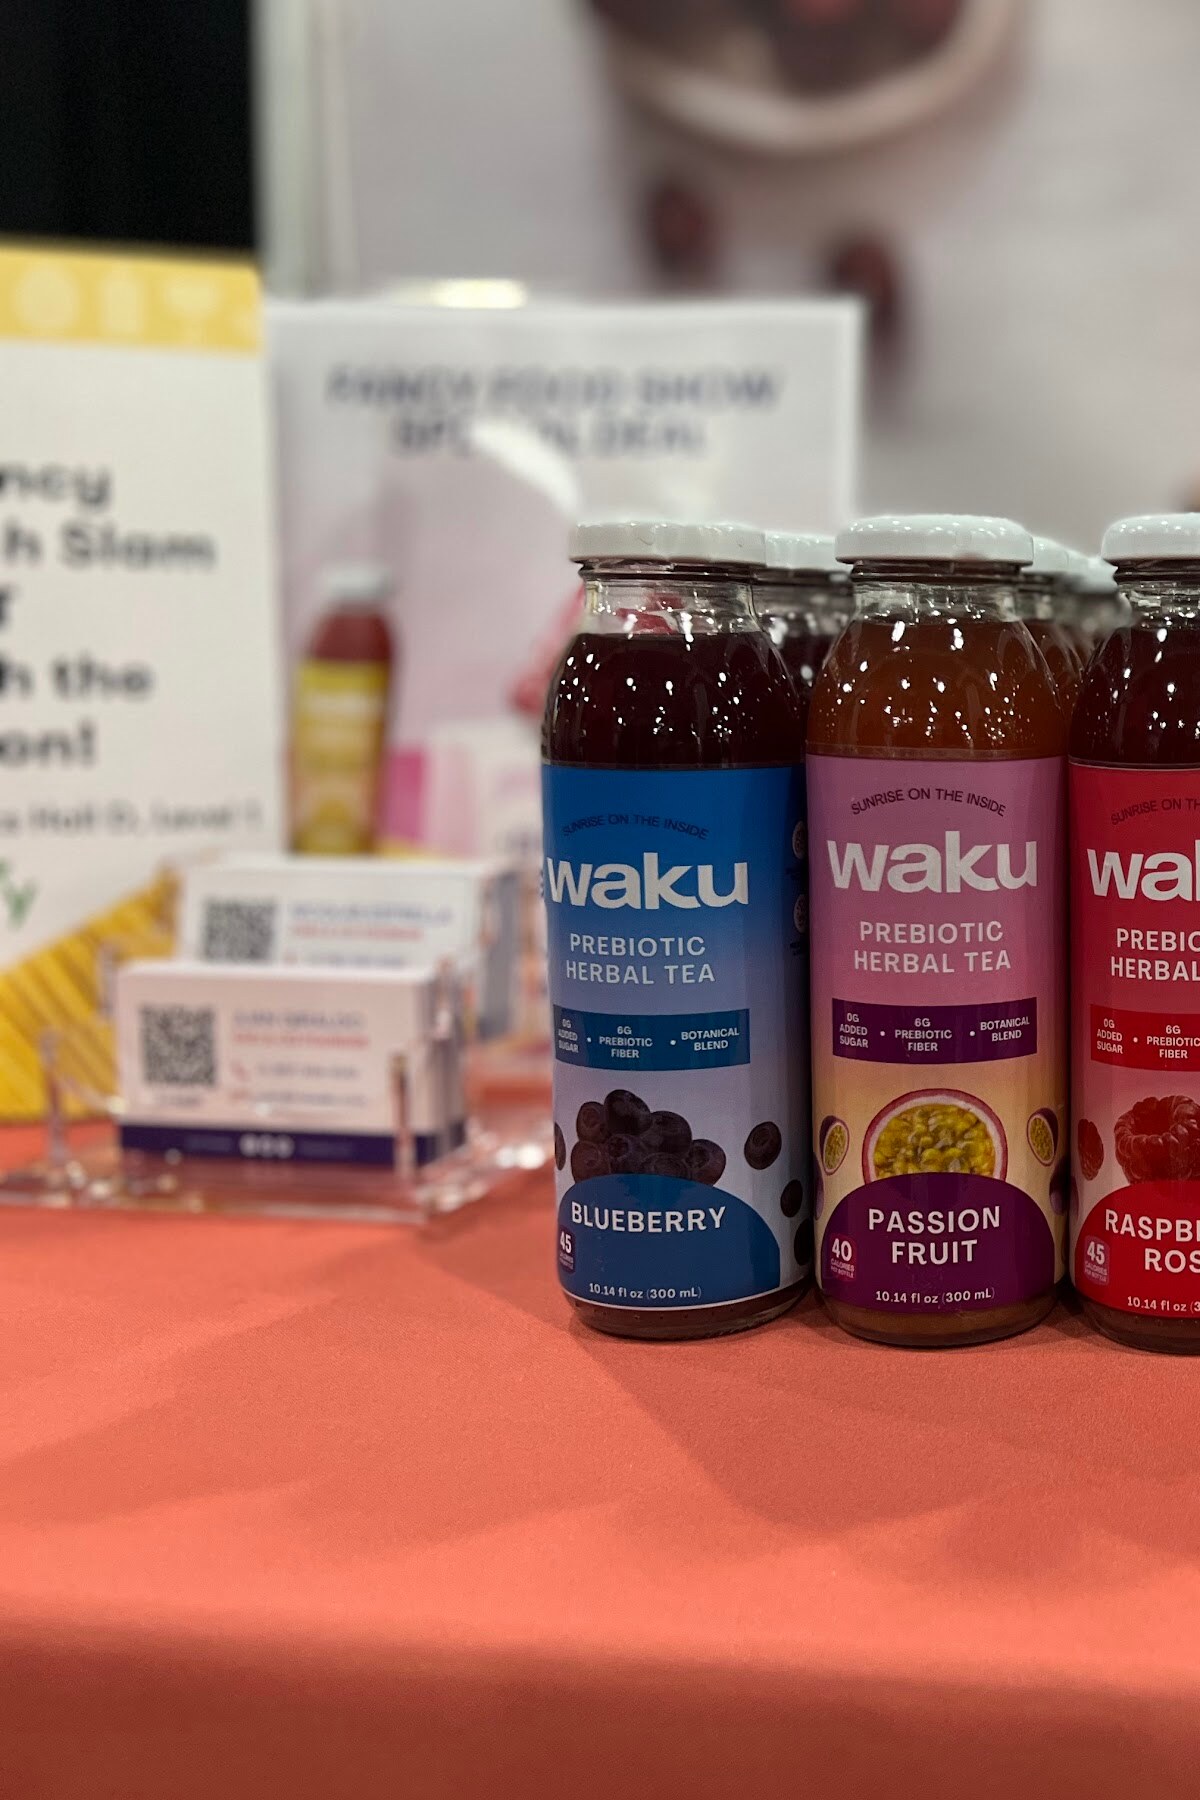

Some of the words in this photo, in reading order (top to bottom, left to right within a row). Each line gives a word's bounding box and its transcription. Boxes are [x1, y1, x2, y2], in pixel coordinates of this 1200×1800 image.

[52, 657, 154, 697] the
[851, 789, 904, 815] SUNRISE
[908, 788, 931, 800] ON
[936, 789, 963, 803] THE
[967, 793, 1006, 817] INSIDE
[1111, 799, 1158, 826] SUNRISE
[1161, 798, 1182, 810] ON
[608, 814, 628, 825] ON
[633, 814, 660, 827] THE
[664, 819, 709, 840] INSIDE
[827, 831, 1037, 893] waku
[546, 852, 749, 909] waku
[860, 921, 1003, 944] PREBIOTIC
[570, 933, 706, 957] PREBIOTIC
[854, 950, 954, 973] HERBAL
[964, 950, 1011, 972] TEA
[566, 960, 654, 985] HERBAL
[664, 963, 716, 984] TEA
[847, 1013, 859, 1022] 0G
[915, 1018, 930, 1027] 6G
[980, 1016, 1030, 1031] BOTANICAL
[1104, 1018, 1115, 1028] 0G
[617, 1026, 631, 1035] 6G
[681, 1028, 739, 1041] BOTANICAL
[839, 1024, 868, 1036] ADDED
[894, 1030, 952, 1039] PREBIOTIC
[992, 1030, 1021, 1041] BLEND
[1097, 1029, 1122, 1041] ADDED
[1166, 1025, 1180, 1034] 6G
[599, 1036, 653, 1047] PREBIOTIC
[694, 1040, 728, 1051] BLEND
[839, 1035, 868, 1048] SUGAR
[908, 1042, 938, 1052] FIBER
[1097, 1041, 1123, 1054] SUGAR
[1146, 1037, 1200, 1047] PREBIOTIC
[611, 1049, 639, 1058] FIBER
[1159, 1049, 1188, 1058] FIBER
[571, 1201, 726, 1233] BLUEBERRY
[868, 1206, 1000, 1234] PASSION
[560, 1231, 572, 1253] 45
[832, 1238, 852, 1262] 40
[892, 1240, 978, 1265] FRUIT
[1087, 1241, 1105, 1265] 45
[589, 1283, 615, 1297] 10.14
[619, 1287, 627, 1297] fl
[630, 1290, 643, 1299] oz
[876, 1290, 907, 1303] 10.14
[911, 1292, 921, 1303] fl
[924, 1295, 938, 1304] oz
[1127, 1296, 1157, 1310] 10.14
[1161, 1301, 1170, 1310] fl
[1173, 1303, 1187, 1312] oz
